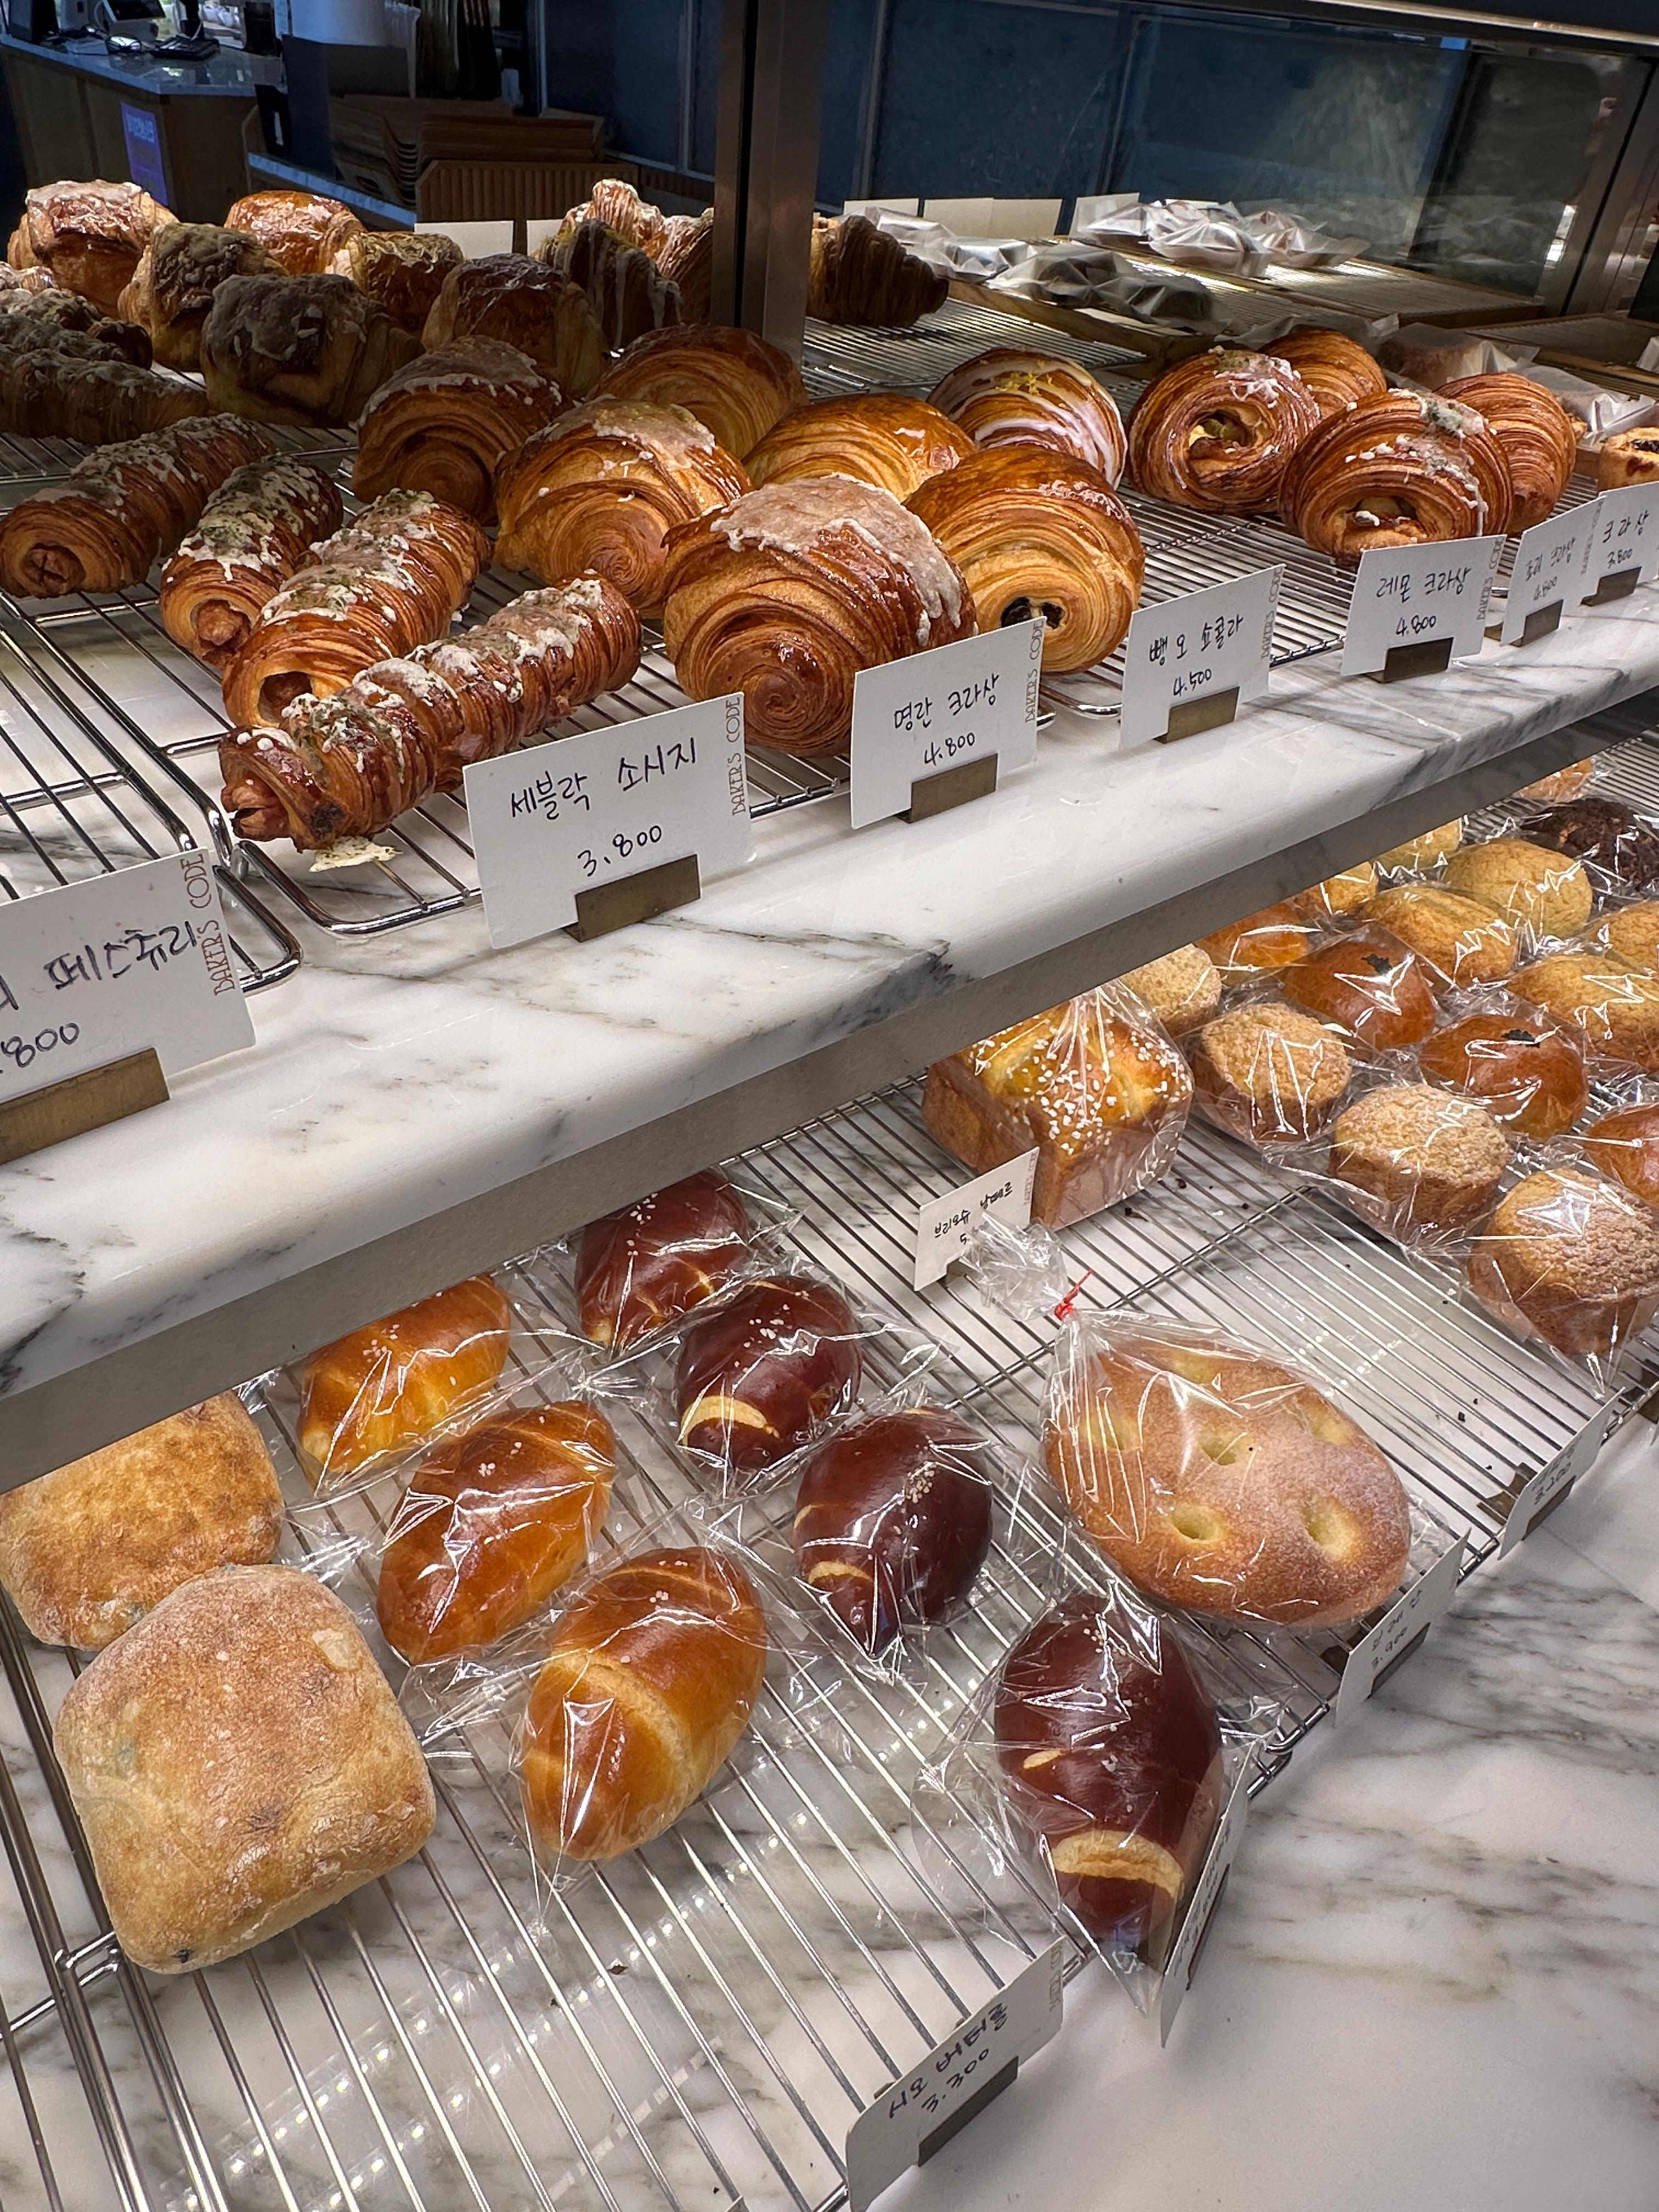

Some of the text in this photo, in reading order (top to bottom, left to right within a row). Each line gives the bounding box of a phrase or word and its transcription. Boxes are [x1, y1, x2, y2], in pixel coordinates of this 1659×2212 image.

[1376, 567, 1472, 603] 레몬 크라상
[1149, 614, 1244, 666] 뺑 오 쇼콜라
[1396, 614, 1437, 637] 4.800
[893, 673, 1000, 731] 명란 크라상
[1025, 621, 1044, 723] BAKER'S CODE
[1173, 668, 1212, 697] 4.500
[510, 737, 697, 820] 세블락 소시지
[725, 696, 747, 816] BAKER'S CODE
[923, 732, 975, 766] 4.800
[43, 921, 198, 990] 페스츄리
[180, 853, 236, 996] BAKER'S CODE
[888, 2002, 1008, 2119] 시오 버터롤
[921, 2048, 990, 2113] 3.300
